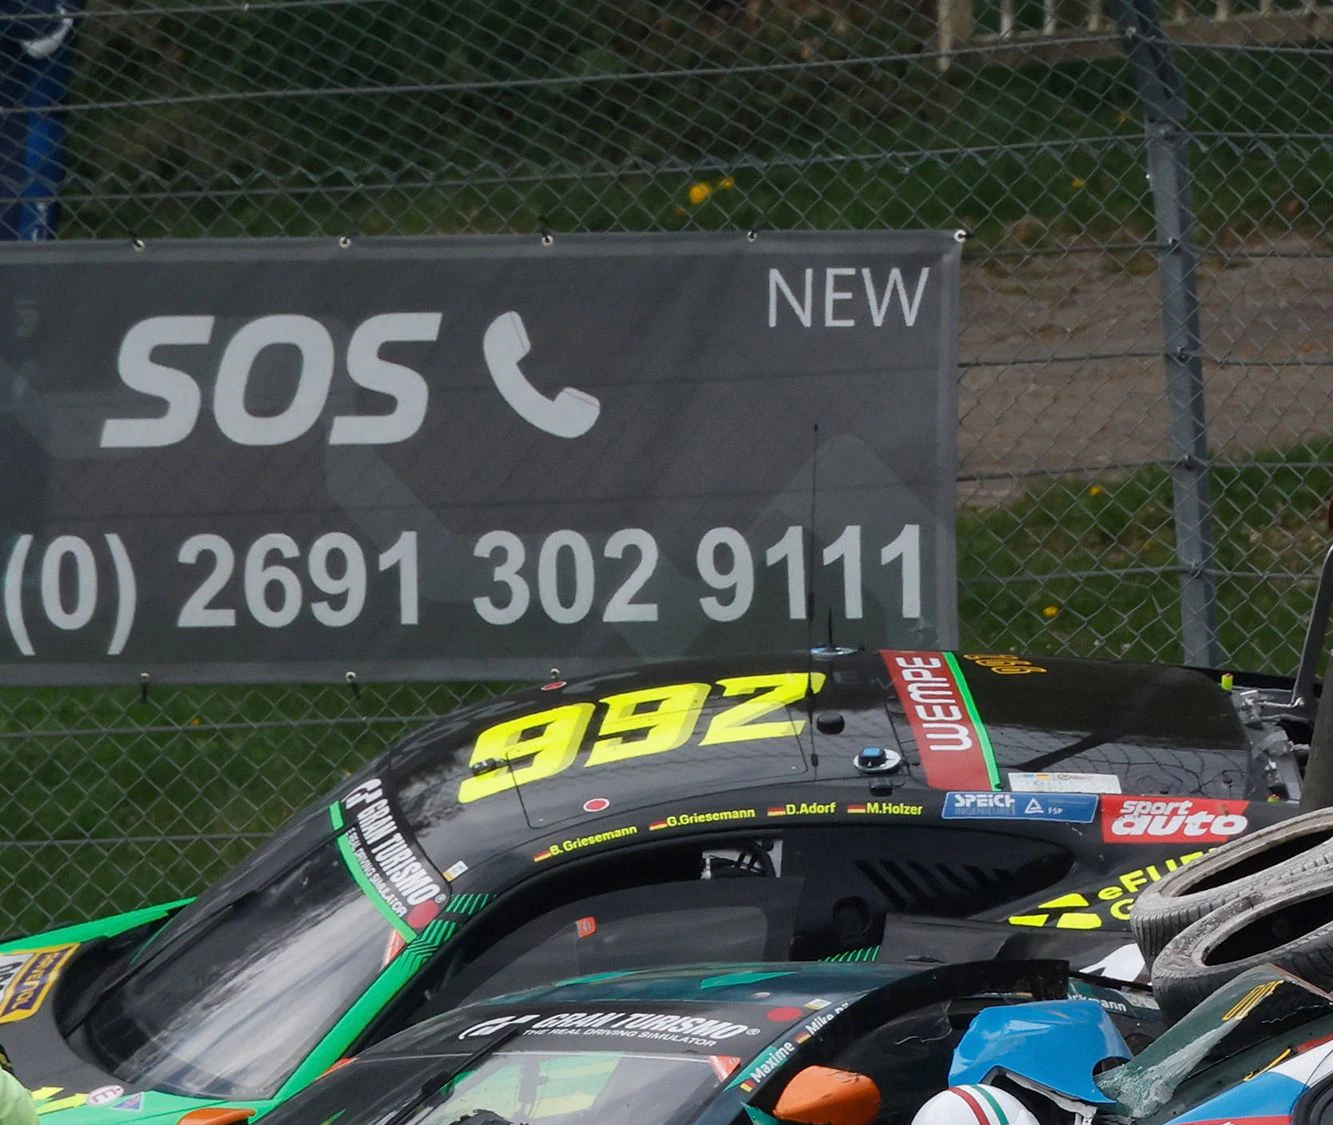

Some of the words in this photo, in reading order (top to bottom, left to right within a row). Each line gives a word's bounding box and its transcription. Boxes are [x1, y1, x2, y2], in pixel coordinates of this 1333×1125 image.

[767, 266, 931, 328] NEW
[99, 311, 443, 449] SOS
[3, 533, 137, 657] (0)
[177, 530, 421, 628] 2691
[472, 527, 660, 623] 302
[696, 523, 922, 620] 9111
[896, 655, 974, 752] WEMPE
[457, 671, 827, 803] 992
[357, 798, 398, 845] GRAN
[785, 801, 837, 816] D.Adorf
[866, 802, 923, 816] M.Holzer
[1110, 810, 1249, 837] auto
[1118, 800, 1195, 816] sport
[562, 823, 639, 852] Griesemann
[531, 1012, 624, 1030] GRAN
[582, 1027, 638, 1038] DRIVING
[637, 1029, 719, 1048] SIMULATOR
[750, 1041, 796, 1084] Maxime
